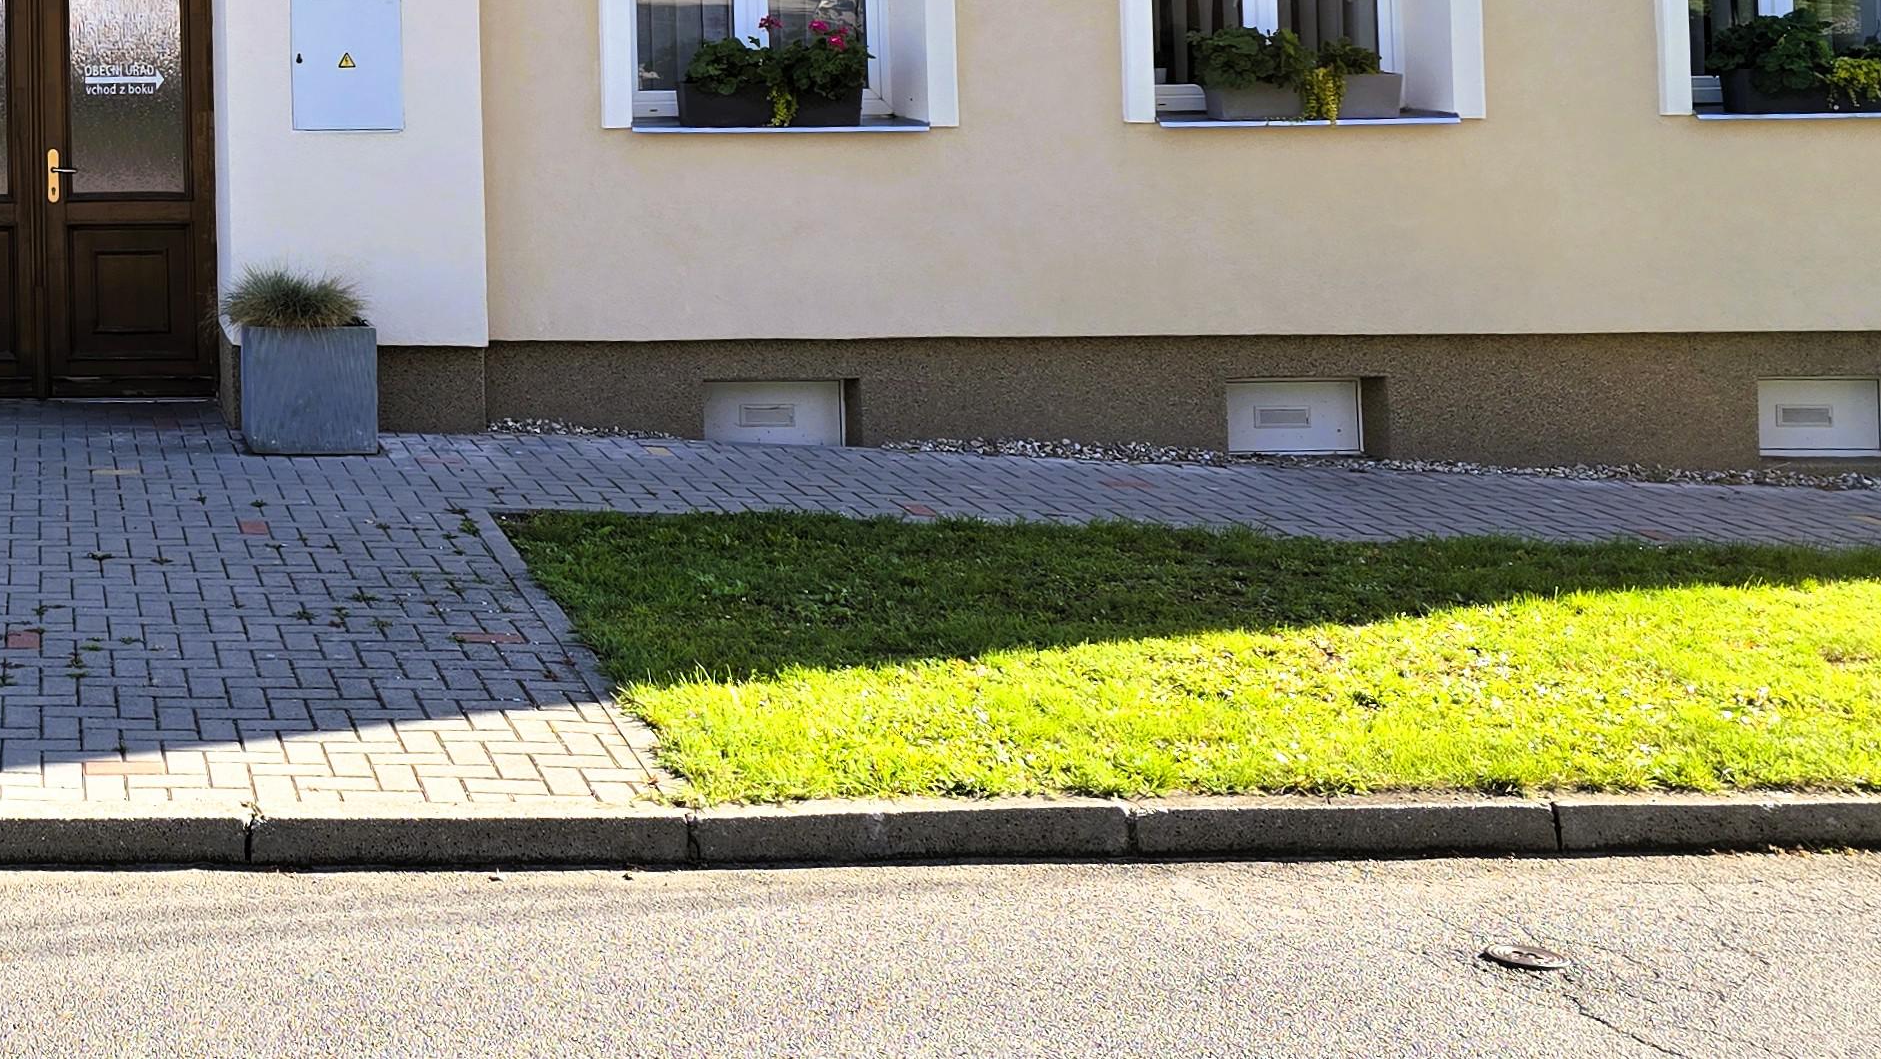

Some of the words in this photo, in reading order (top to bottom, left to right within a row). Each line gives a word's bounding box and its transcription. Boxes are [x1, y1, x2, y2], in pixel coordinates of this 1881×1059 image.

[85, 84, 117, 95] vchod
[119, 86, 125, 94] z
[128, 84, 154, 95] boku
